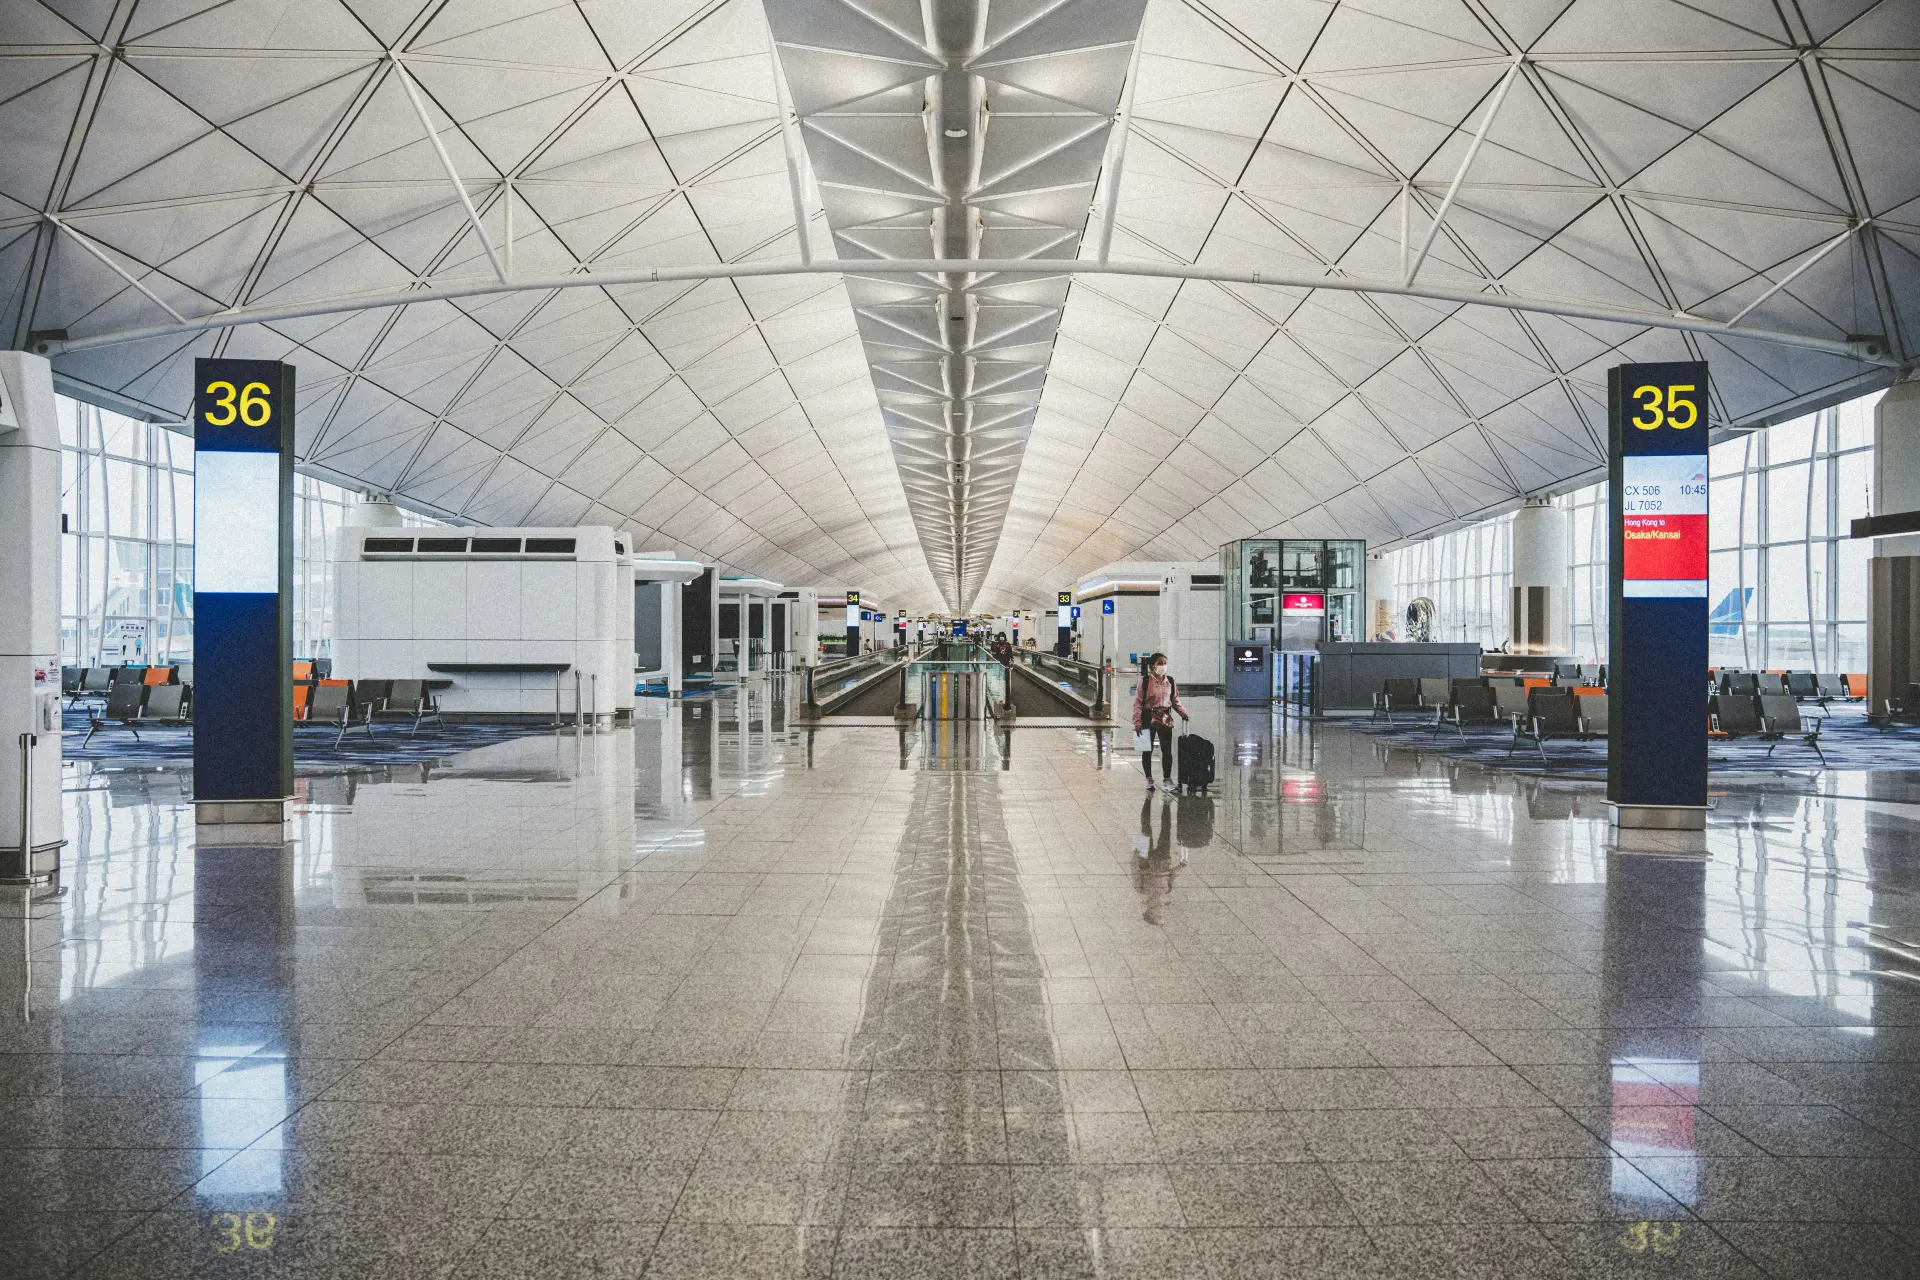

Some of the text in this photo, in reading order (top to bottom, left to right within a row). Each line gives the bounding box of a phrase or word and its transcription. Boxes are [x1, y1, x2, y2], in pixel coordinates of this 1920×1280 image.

[205, 381, 271, 427] 36
[1632, 384, 1698, 430] 35
[1624, 485, 1660, 496] CX 506
[1680, 484, 1706, 495] 10:45
[1624, 500, 1662, 511] JL 7052
[1624, 519, 1641, 527] Hong
[1642, 519, 1658, 527] Kong
[1624, 530, 1681, 539] Osaka/Kansai
[848, 594, 858, 602] 34
[1060, 594, 1070, 602] 33
